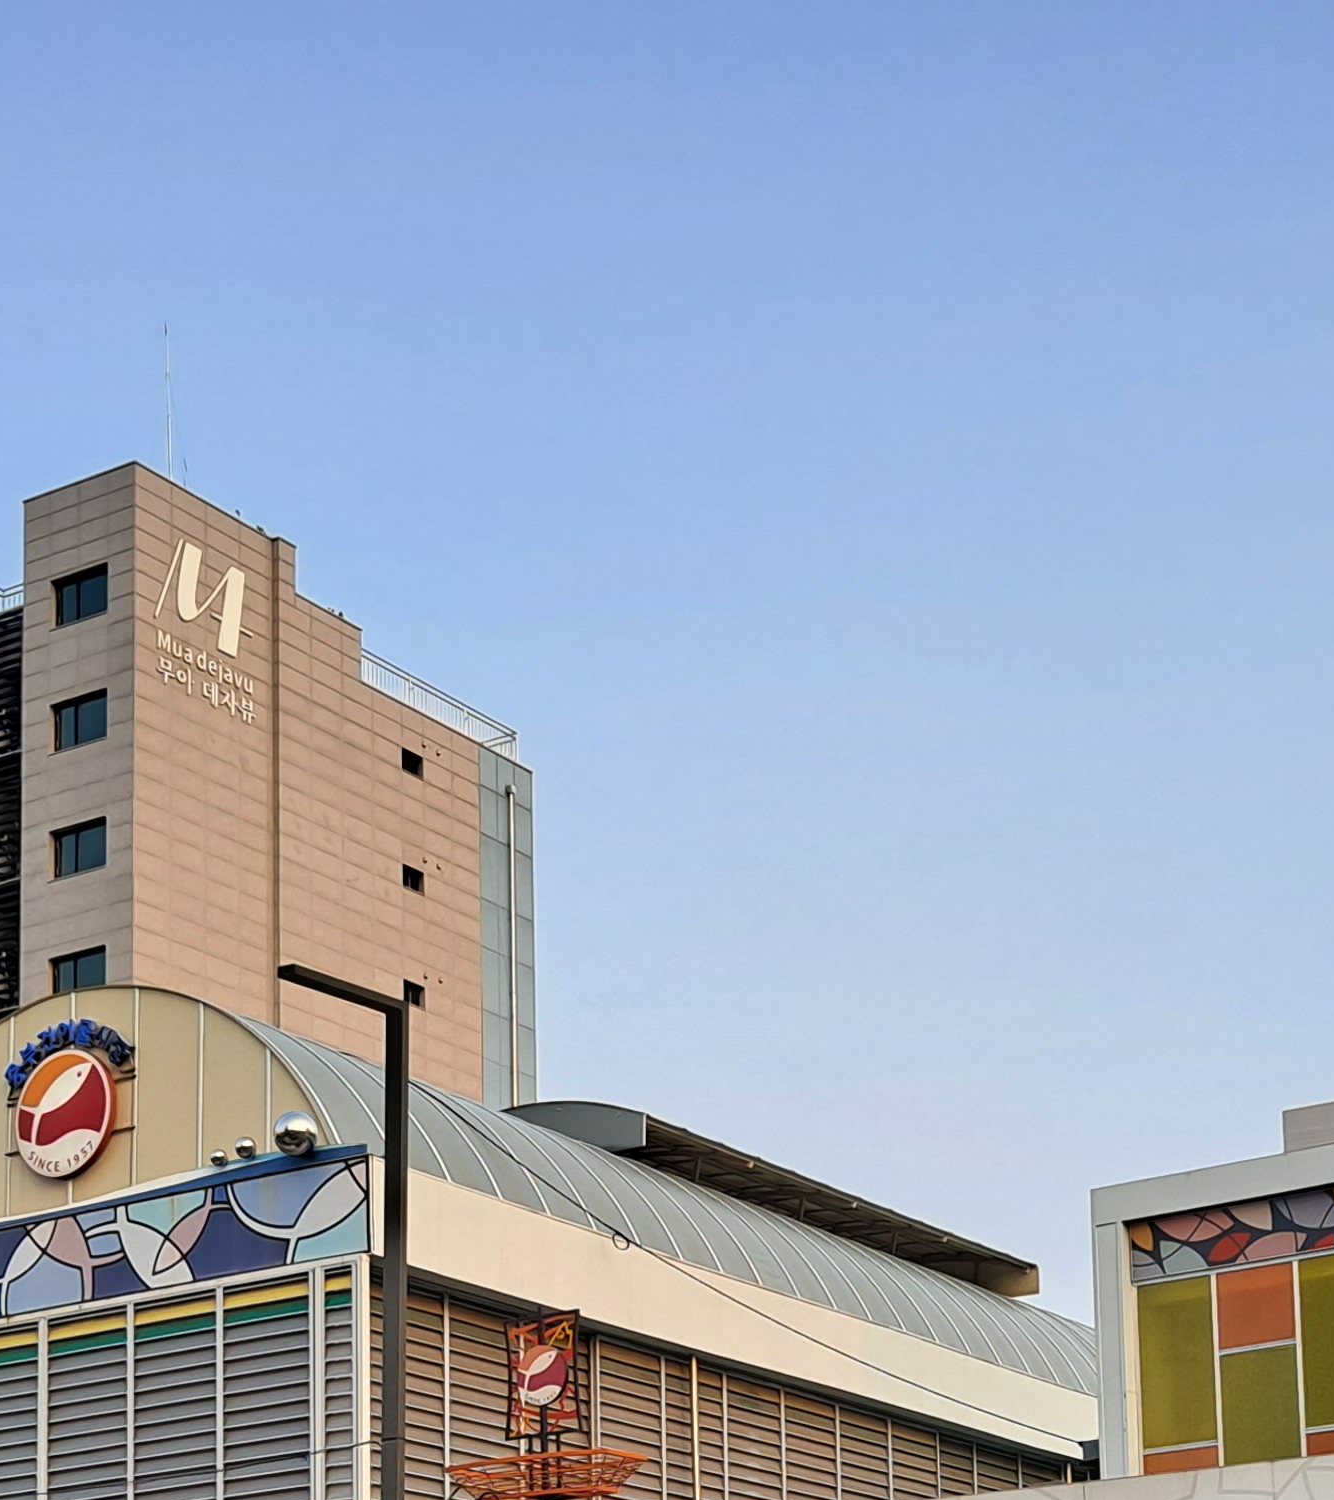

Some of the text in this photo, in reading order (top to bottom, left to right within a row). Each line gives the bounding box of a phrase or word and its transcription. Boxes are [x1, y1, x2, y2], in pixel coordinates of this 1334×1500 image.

[157, 630, 255, 695] Mua dejavu
[157, 656, 256, 724] 무아 데자뷰
[28, 1140, 94, 1173] SINCE 1957
